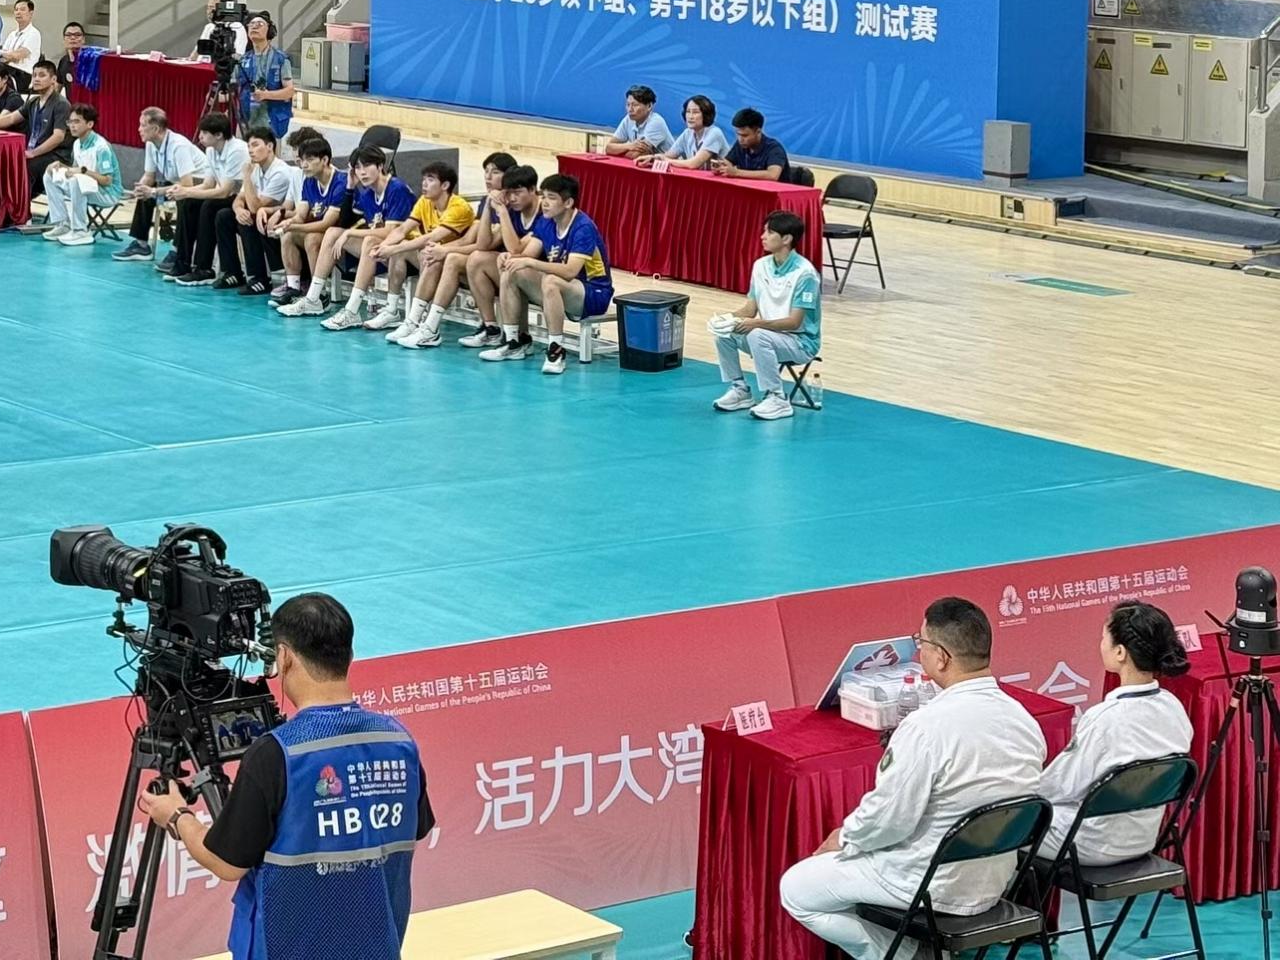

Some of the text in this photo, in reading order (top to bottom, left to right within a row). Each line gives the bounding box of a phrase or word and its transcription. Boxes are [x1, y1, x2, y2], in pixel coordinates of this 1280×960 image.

[1027, 565, 1189, 604] 中华人民共和国第十五届运动会
